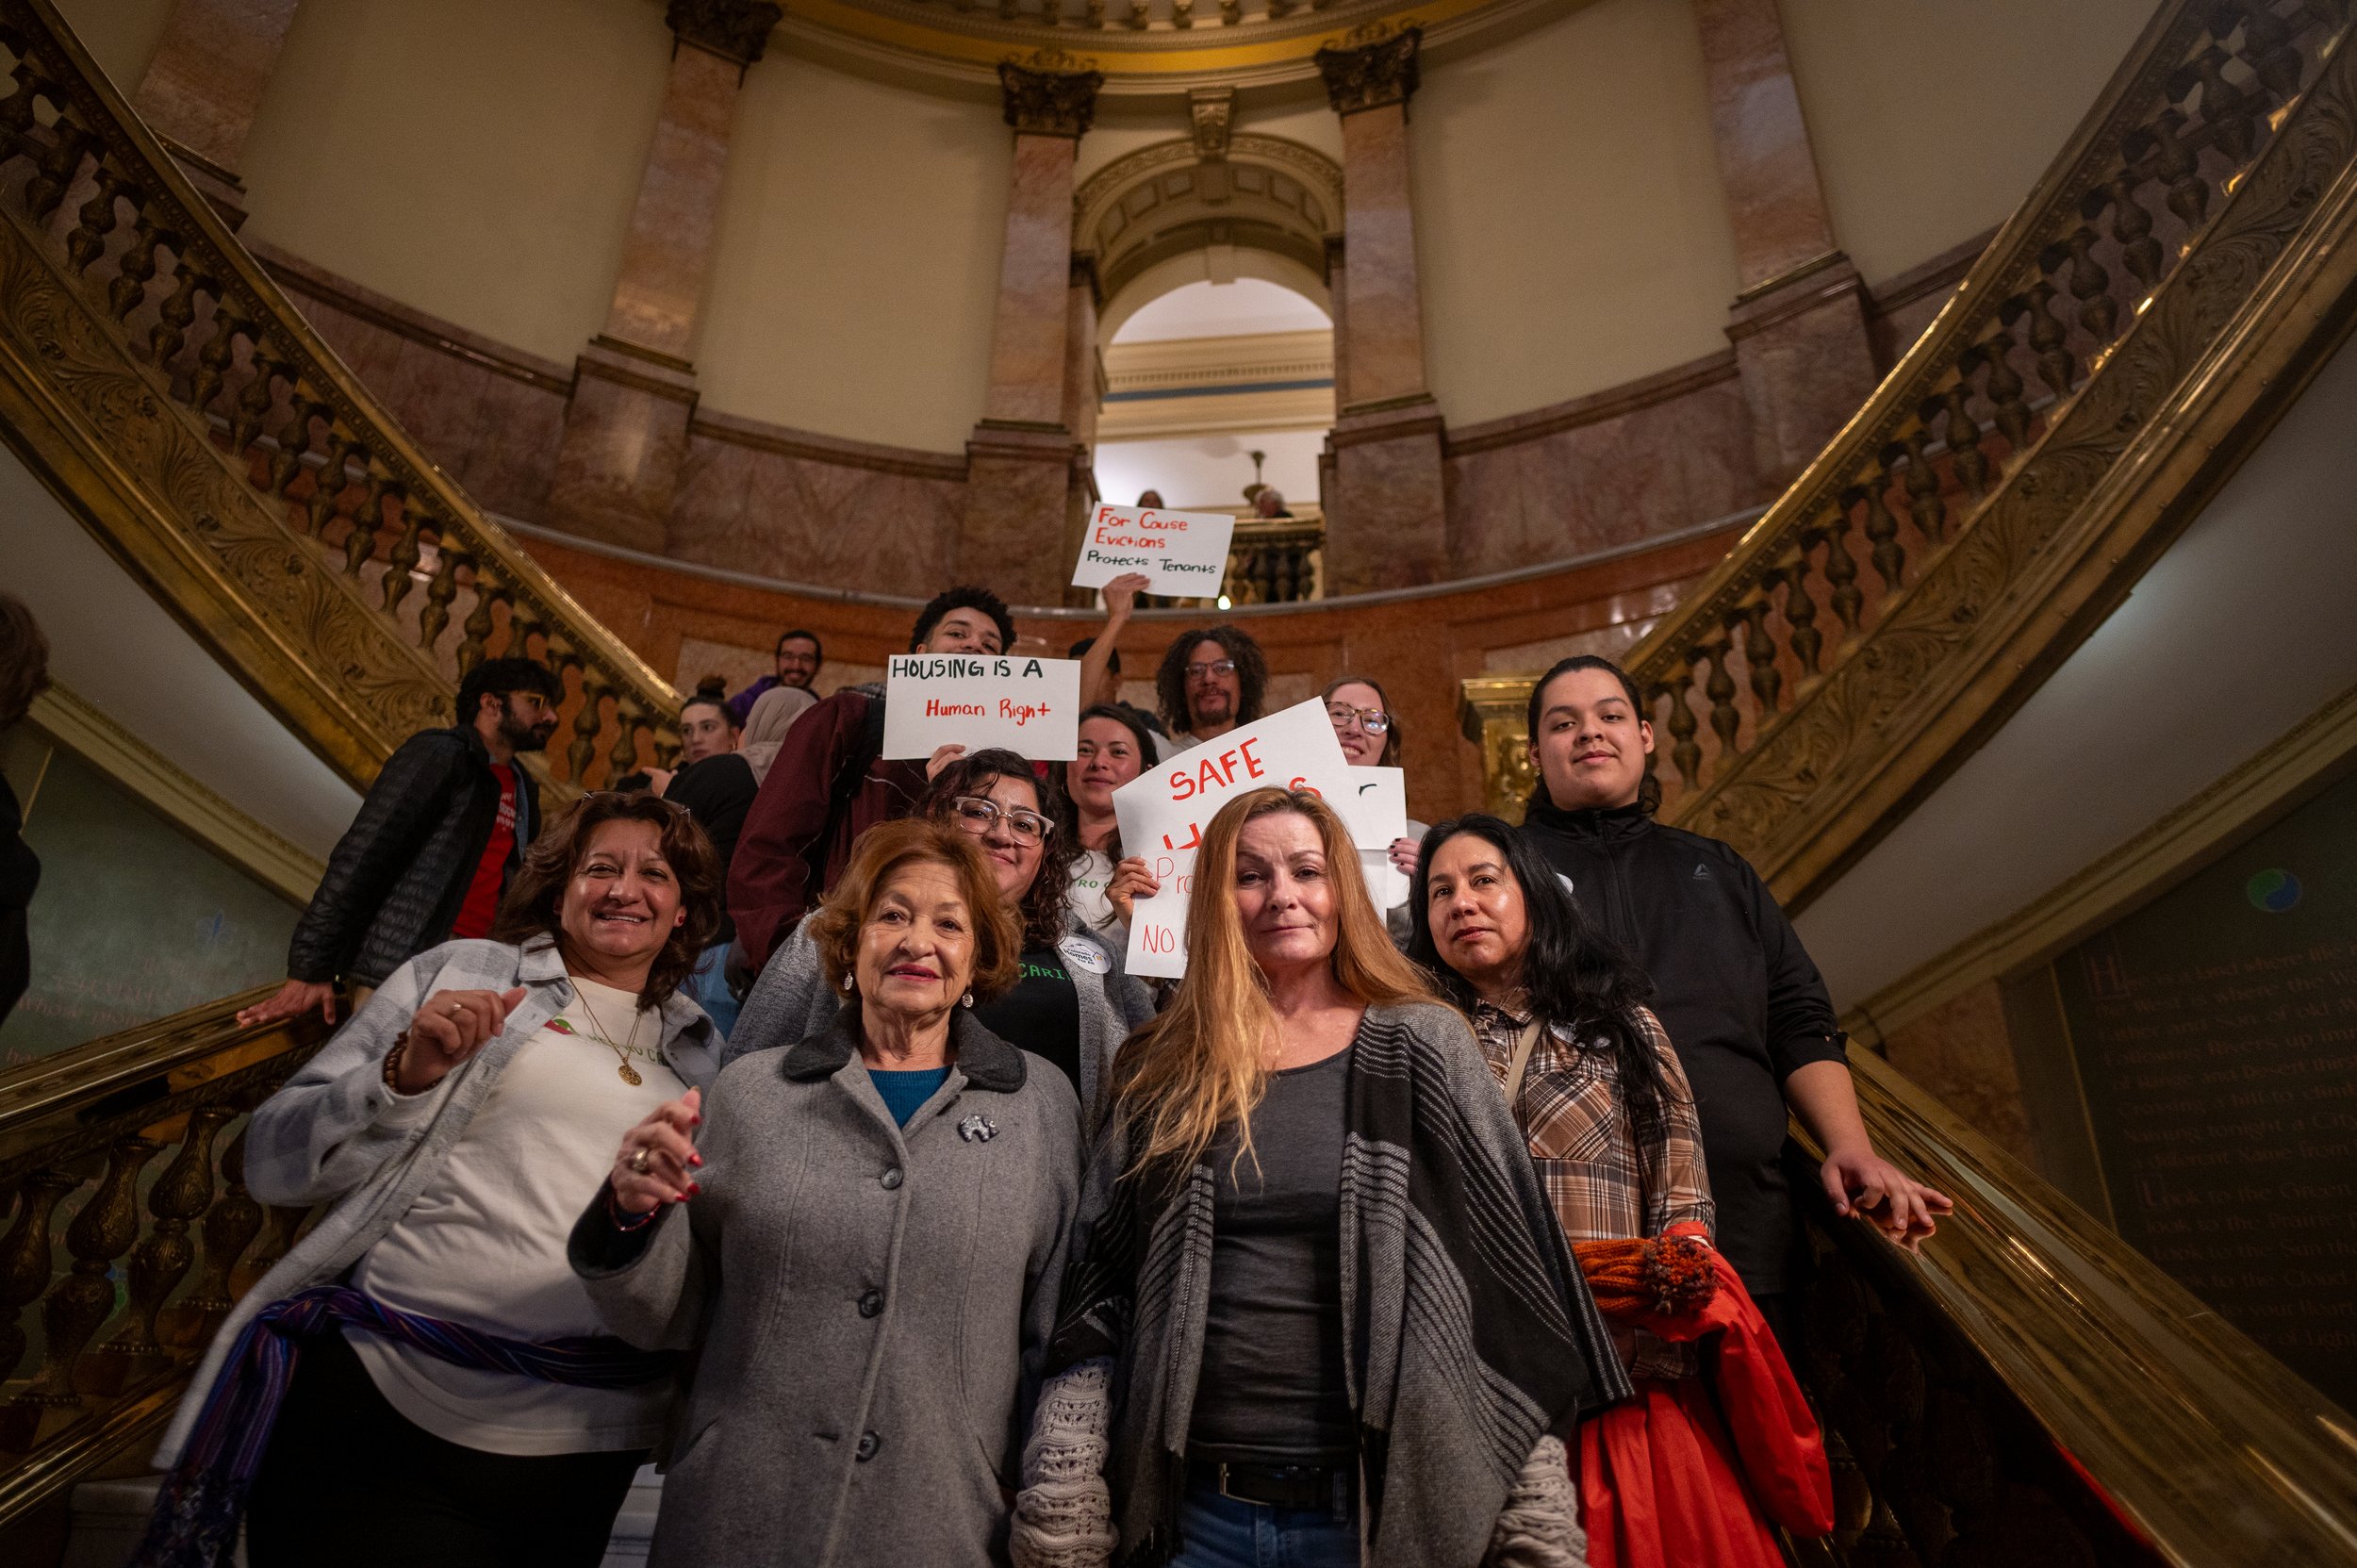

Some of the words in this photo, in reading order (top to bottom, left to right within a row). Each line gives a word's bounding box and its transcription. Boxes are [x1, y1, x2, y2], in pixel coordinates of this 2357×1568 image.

[1098, 507, 1130, 526] For
[1140, 511, 1188, 531] Cause
[1096, 527, 1165, 549] Evictions
[1087, 550, 1149, 566] Protects
[1160, 558, 1216, 574] Tenants
[893, 659, 984, 680] HOUSING
[994, 659, 1011, 677] IS
[1022, 659, 1043, 678] A
[926, 699, 985, 717] Human
[1169, 736, 1264, 801] SAFE
[1143, 924, 1175, 953] NO
